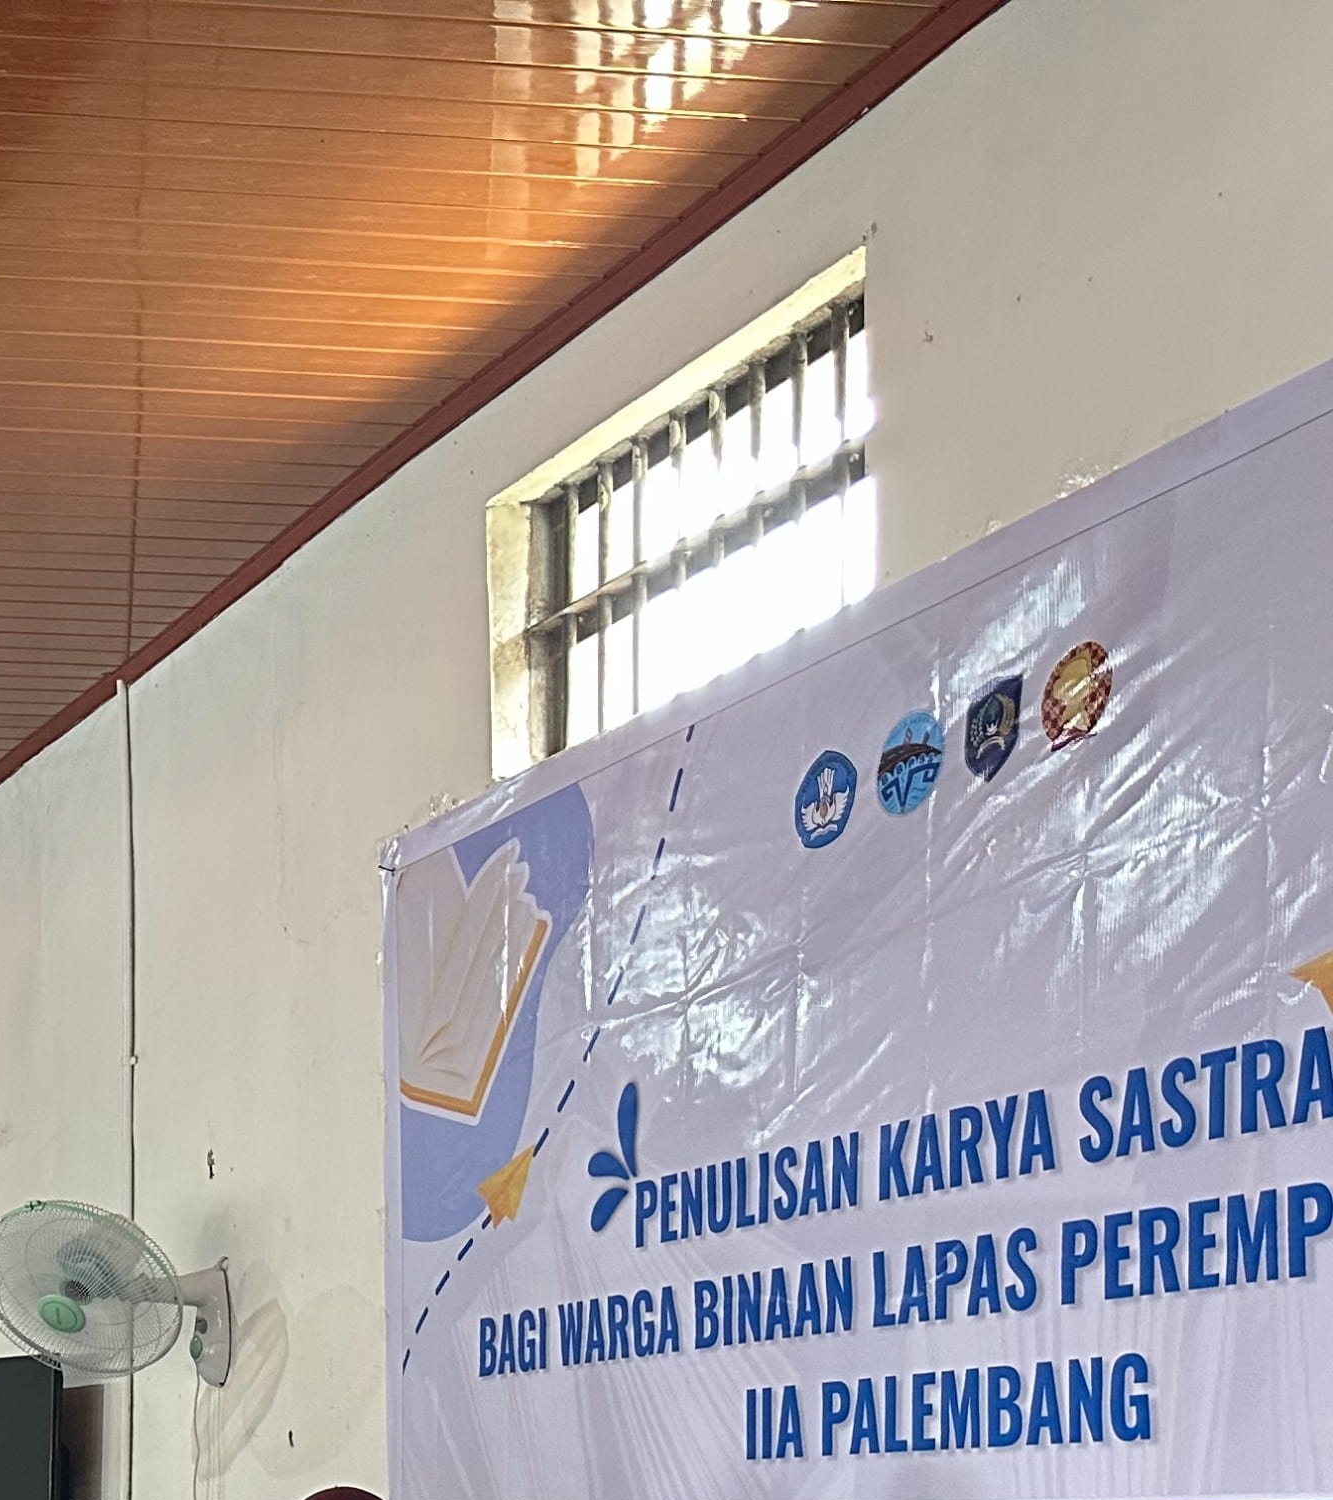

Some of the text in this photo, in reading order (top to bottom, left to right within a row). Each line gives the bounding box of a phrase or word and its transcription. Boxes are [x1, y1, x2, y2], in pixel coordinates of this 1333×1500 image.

[635, 1026, 1333, 1249] PENULISAN KARYA SASTRA
[478, 1307, 547, 1378] BAGI
[558, 1286, 681, 1367] WARGA
[694, 1256, 852, 1350] BINAAN
[873, 1227, 1037, 1328] LAPAS
[746, 1352, 1151, 1460] IIA PALEMBANG
